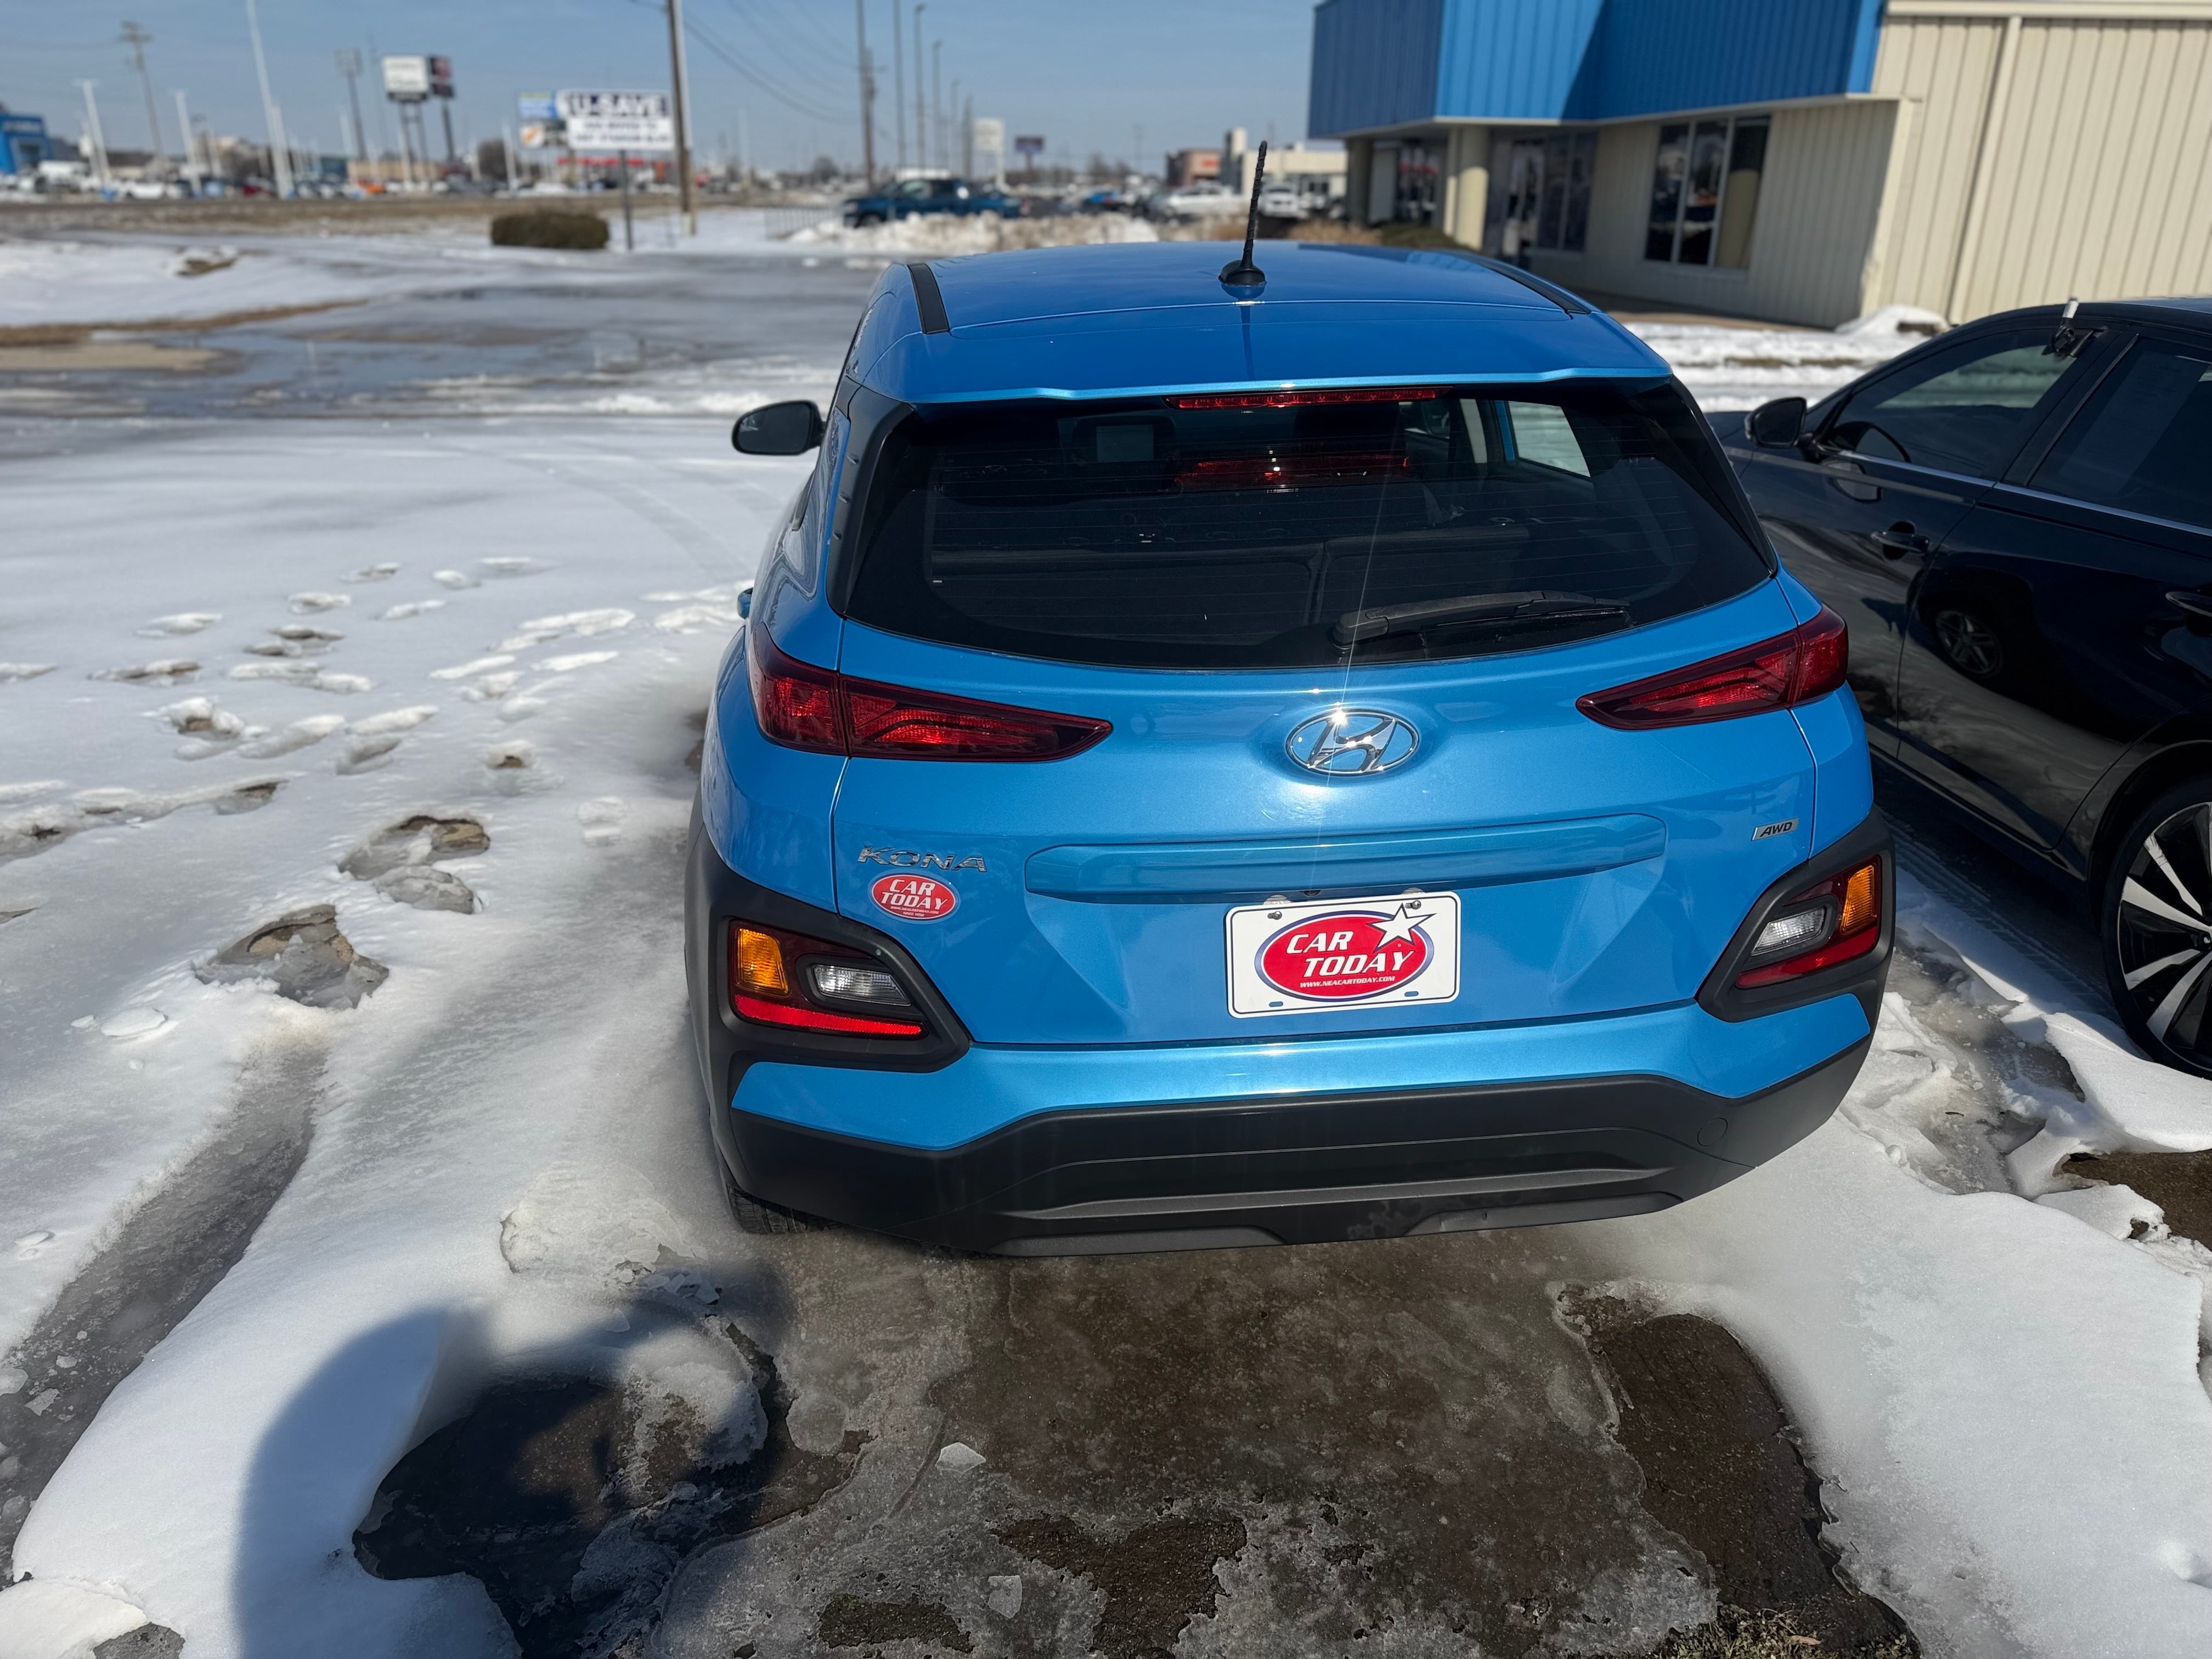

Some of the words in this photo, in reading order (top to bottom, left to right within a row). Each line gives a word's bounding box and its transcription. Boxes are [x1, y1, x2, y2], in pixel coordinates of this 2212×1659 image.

[1759, 821, 1793, 837] AWD
[857, 845, 988, 873] KONA
[889, 879, 936, 896] CAR
[881, 891, 948, 910] TODAY
[1286, 930, 1354, 954] CAR
[1303, 950, 1415, 978] TODAY
[1300, 975, 1396, 988] WWW.NEACARTODAY.COM
